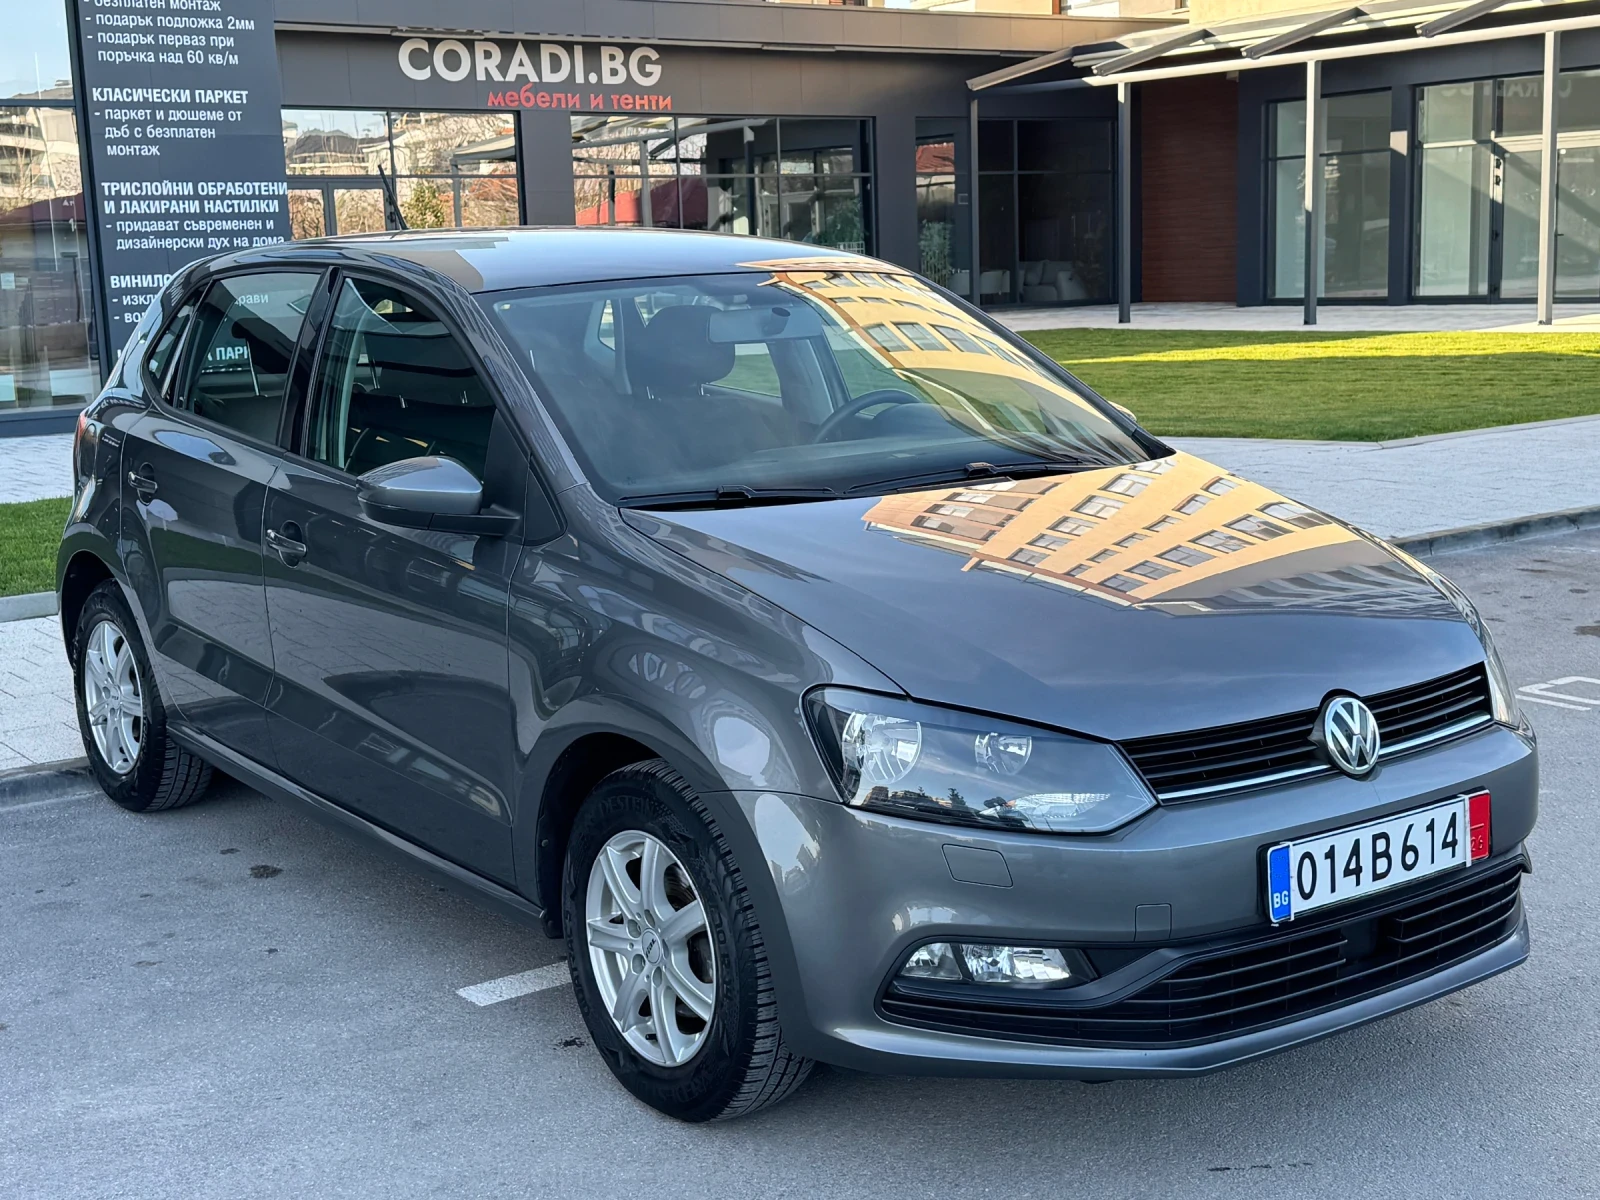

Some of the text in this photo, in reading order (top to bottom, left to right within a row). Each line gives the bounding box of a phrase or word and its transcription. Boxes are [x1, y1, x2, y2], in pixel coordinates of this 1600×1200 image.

[170, 0, 221, 11] монтаж
[96, 14, 255, 30] подарък подложка 2мм
[98, 32, 234, 48] подарък перваз при
[98, 51, 238, 66] поръчка над 60 кв/м
[398, 38, 662, 87] CORADI.BG
[92, 87, 248, 104] КЛАСИЧЕСКИ ПАРКЕТ
[487, 82, 672, 111] мебели и тенти
[105, 108, 242, 122] паркет и дюшеме от
[105, 124, 216, 140] дъб с безплатен
[107, 144, 160, 156] монтаж
[101, 180, 287, 196] ТРИСЛОЙНИ ОБРАБОТЕНИ
[104, 200, 279, 214] И ЛАКИРАНИ НАСТИЛКИ
[116, 219, 274, 234] придават съвременен и
[117, 235, 284, 250] дизайнерски дух на дома
[123, 293, 269, 307] изкл рави
[125, 312, 143, 323] во
[1273, 811, 1458, 909] BG 014B614
